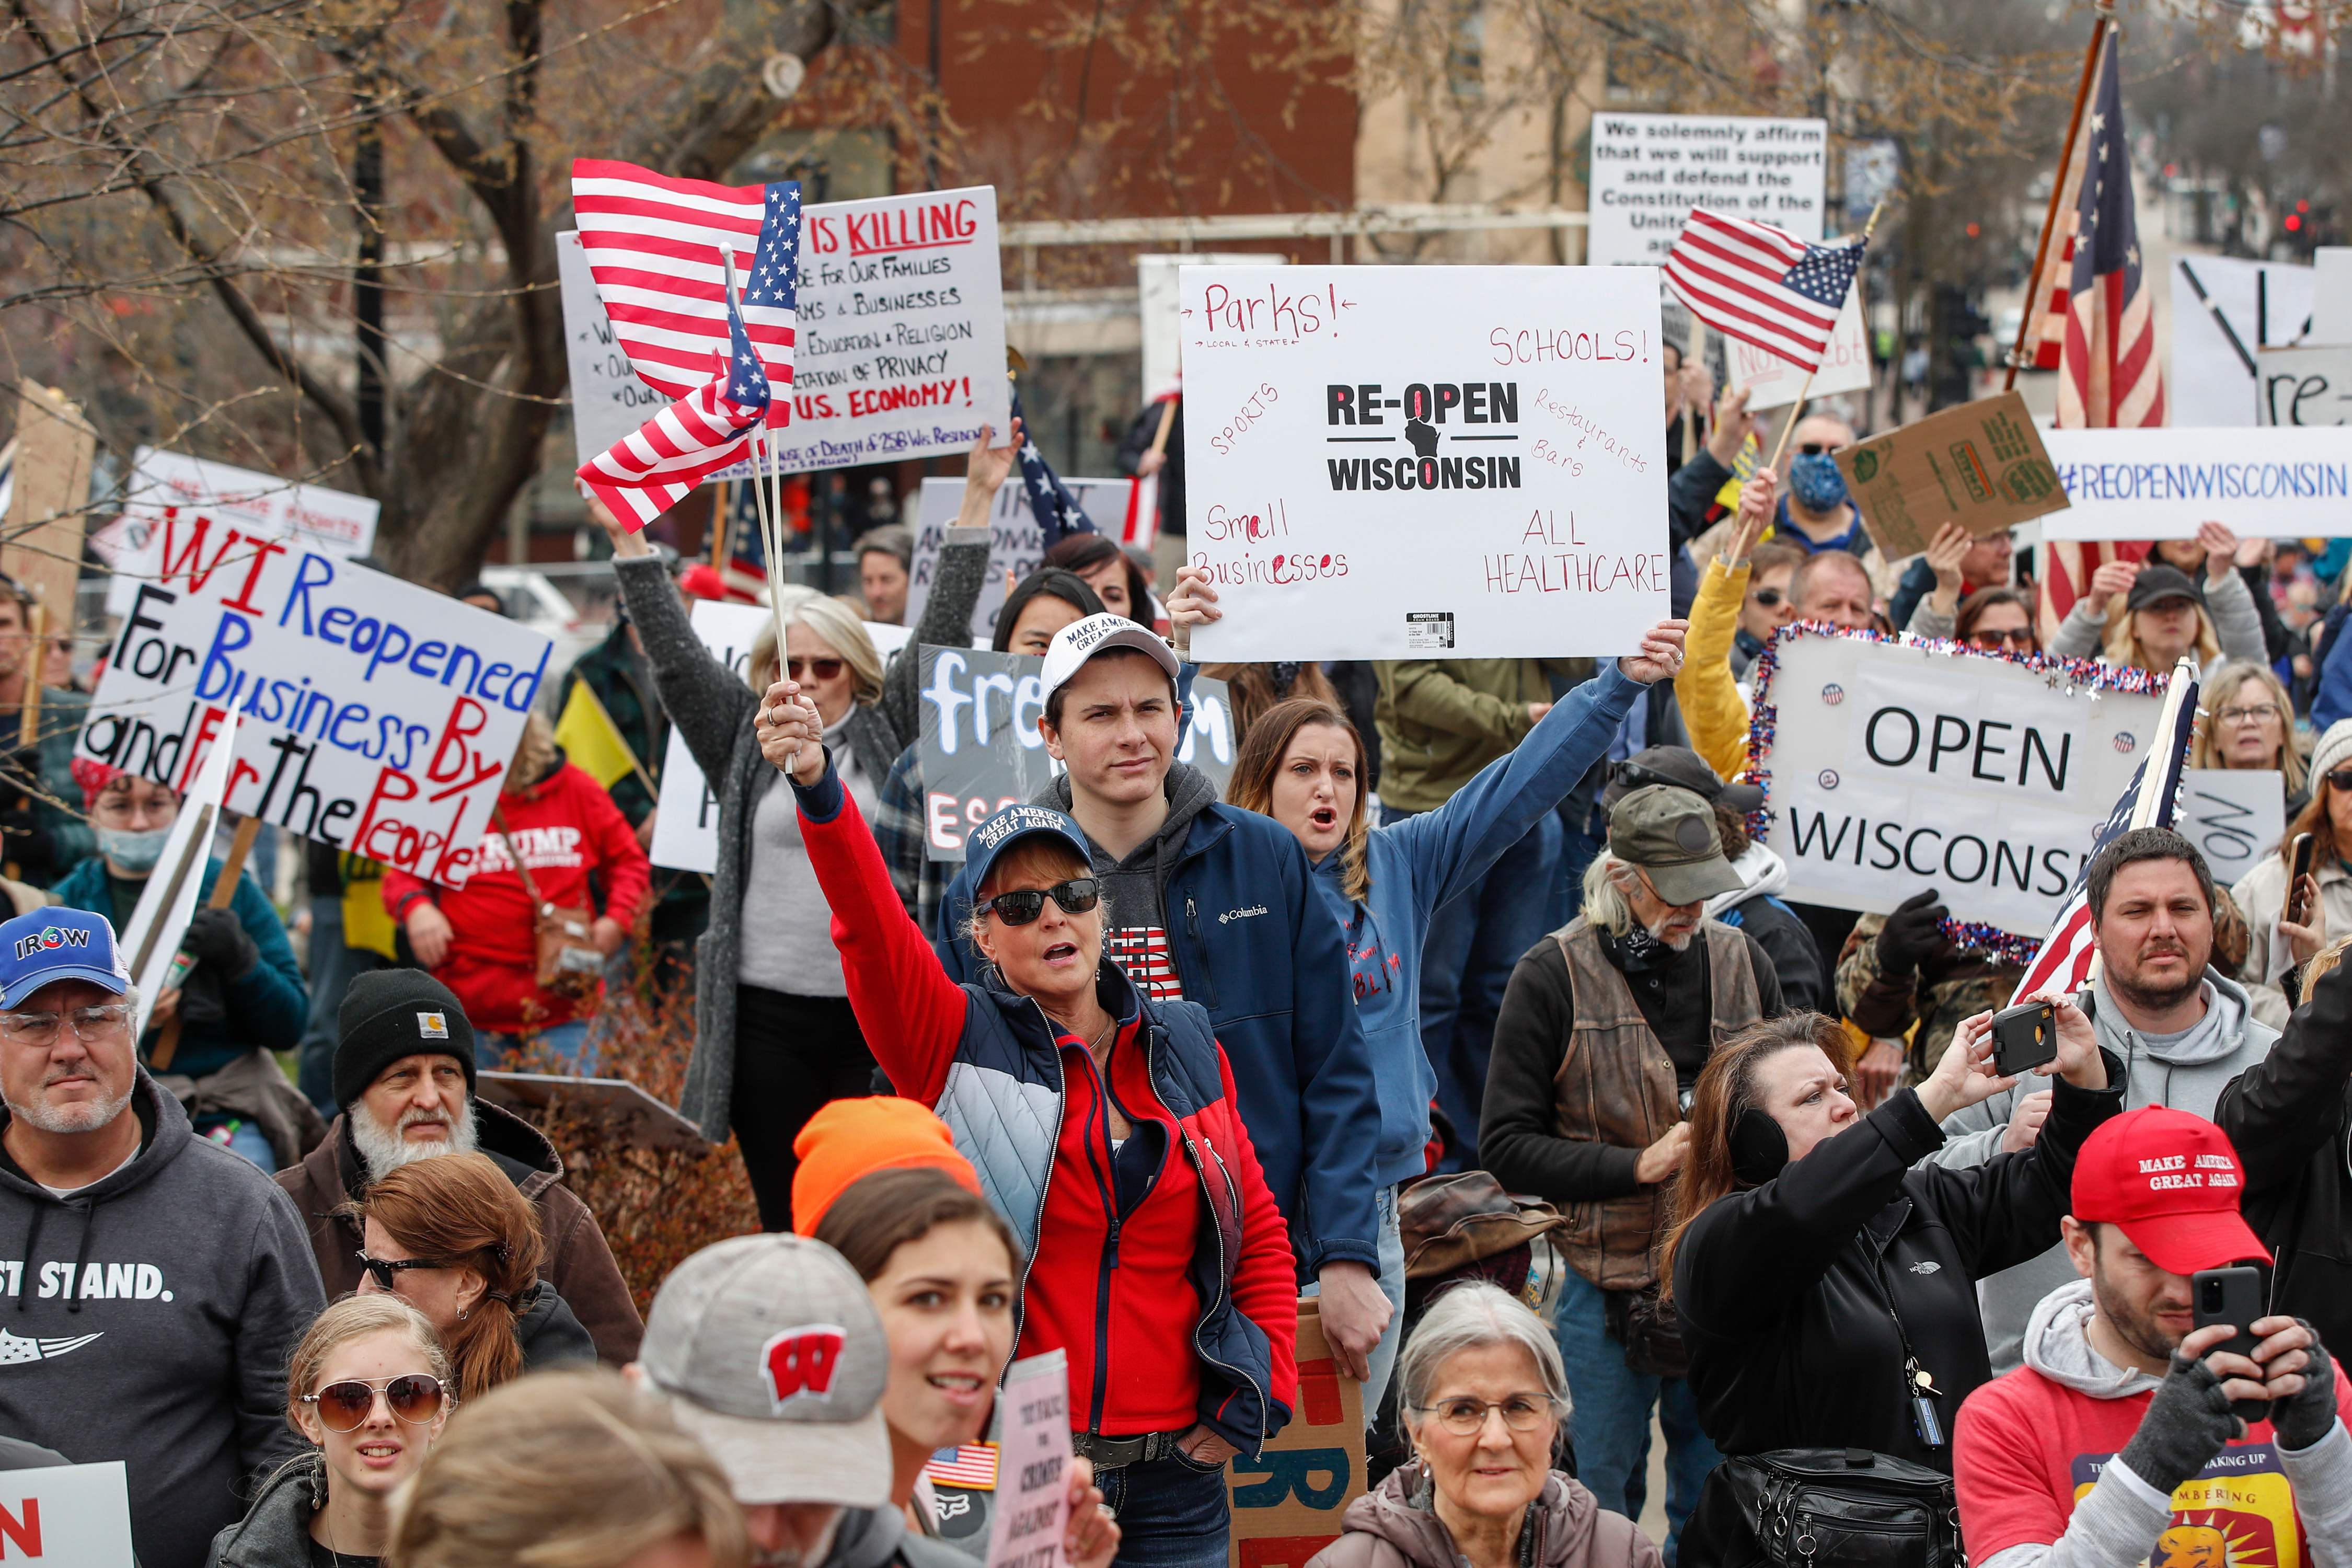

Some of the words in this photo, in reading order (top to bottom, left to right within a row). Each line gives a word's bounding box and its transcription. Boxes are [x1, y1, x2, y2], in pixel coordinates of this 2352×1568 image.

[1605, 121, 1638, 138] We
[1647, 121, 1747, 144] solemnly
[1755, 125, 1821, 142] affirm
[1597, 144, 1639, 159] that
[1651, 147, 1680, 162] we
[1689, 146, 1728, 164] will
[1736, 151, 1822, 171] support
[1625, 169, 1664, 184] and
[1674, 169, 1749, 187] defend
[1757, 171, 1792, 188] the
[1601, 189, 1740, 209] Constitution
[1747, 191, 1770, 209] of
[1779, 192, 1813, 210] the
[810, 216, 839, 254] IS
[846, 199, 977, 251] KILLING
[1630, 213, 1688, 229] Unite
[882, 256, 952, 279] FAMILIES
[854, 287, 962, 316] BUSINESSES
[1204, 284, 1339, 338] Parks!
[807, 330, 882, 356] EDUCATION
[893, 320, 973, 346] RELIGION
[1490, 327, 1648, 365] SCHOOLS!
[875, 349, 949, 379] PRIVACY
[794, 394, 841, 421] U.S.
[1210, 383, 1278, 455] SPORTS
[1327, 382, 1518, 425] RE-OPEN
[1534, 388, 1648, 474] Restaurants
[1327, 456, 1521, 491] WISCONSIN
[1531, 439, 1584, 477] Bars
[2057, 462, 2348, 500] #REOPENWISCONSIN
[1206, 499, 1289, 544] Small
[1522, 510, 1586, 546] ALL
[1192, 552, 1349, 587] Businesses
[1484, 553, 1667, 594] HEALTHCARE
[159, 506, 286, 617] WI
[279, 552, 554, 713] Reopened
[1066, 621, 1098, 645] MAKE
[1077, 628, 1110, 651] GREAT
[112, 583, 198, 685] For
[194, 612, 430, 770] Business
[426, 696, 502, 803] By
[921, 650, 1231, 767] frem
[1865, 706, 2072, 792] OPEN
[84, 701, 198, 785] and
[179, 706, 259, 809] Fr
[255, 733, 356, 846] the
[349, 766, 475, 888] People
[976, 814, 1007, 845] MAKE
[1010, 808, 1067, 827] AMERICA
[986, 818, 1020, 850] GREAT
[1025, 816, 1063, 831] AGAIN
[1790, 806, 2086, 898] WISCONS
[1229, 904, 1268, 920] Columbia
[14, 926, 90, 961] IROW
[2138, 1154, 2187, 1174] MAKE
[2194, 1154, 2235, 1170] AMERICA
[2149, 1173, 2203, 1191] GREAT
[2207, 1173, 2239, 1187] AGAIN
[38, 1261, 174, 1302] STAND.
[2248, 1453, 2267, 1465] UP
[2172, 1488, 2258, 1504] MBERING
